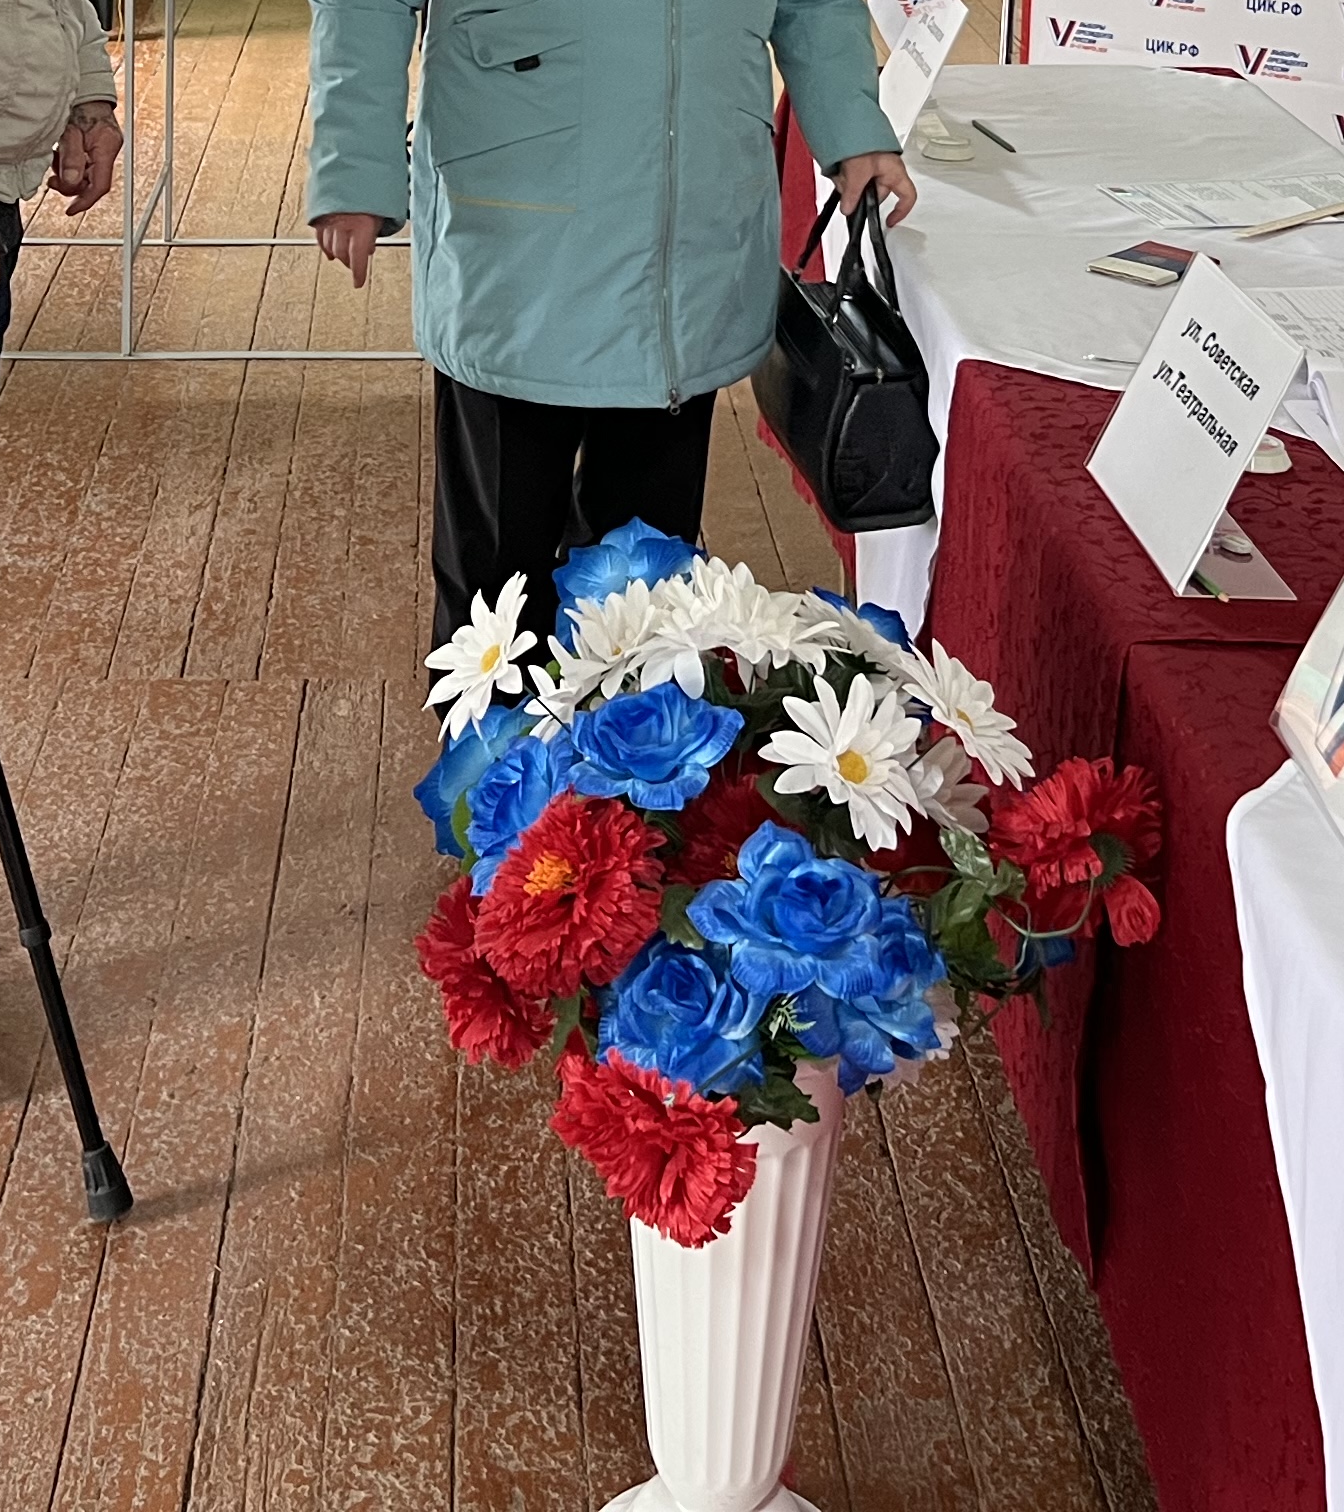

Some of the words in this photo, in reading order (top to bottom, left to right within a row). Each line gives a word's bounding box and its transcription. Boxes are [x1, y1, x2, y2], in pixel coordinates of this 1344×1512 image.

[1146, 38, 1199, 57] ЦИК.РФ
[1180, 317, 1201, 344] ул.
[1201, 331, 1261, 401] Советская
